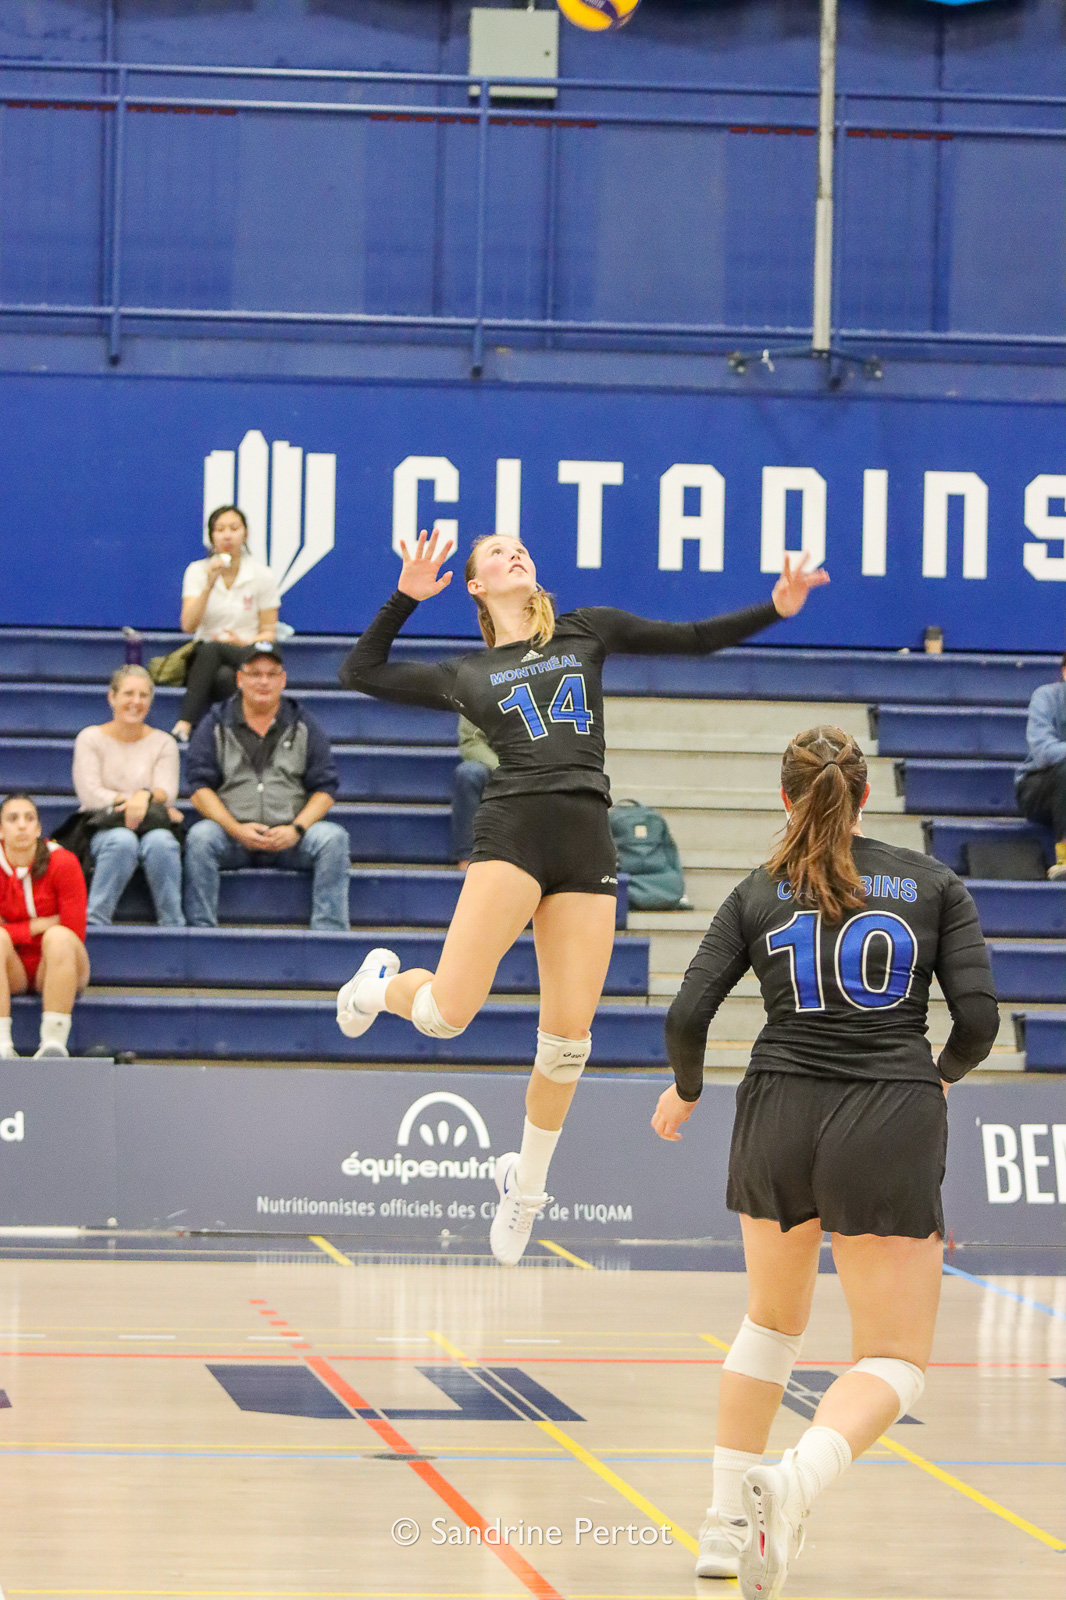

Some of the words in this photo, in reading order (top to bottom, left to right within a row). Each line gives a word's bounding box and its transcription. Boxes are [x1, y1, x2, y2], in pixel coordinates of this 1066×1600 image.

[392, 455, 1066, 581] CITADINS
[490, 654, 582, 686] MONTRÉAL
[498, 673, 594, 741] 14
[777, 875, 917, 903] CBINS
[766, 910, 918, 1013] 10
[341, 1151, 497, 1185] équipenutri
[256, 1196, 375, 1216] Nutritionnistes
[380, 1199, 442, 1218] officiels
[447, 1200, 476, 1219] des
[549, 1202, 570, 1221] de
